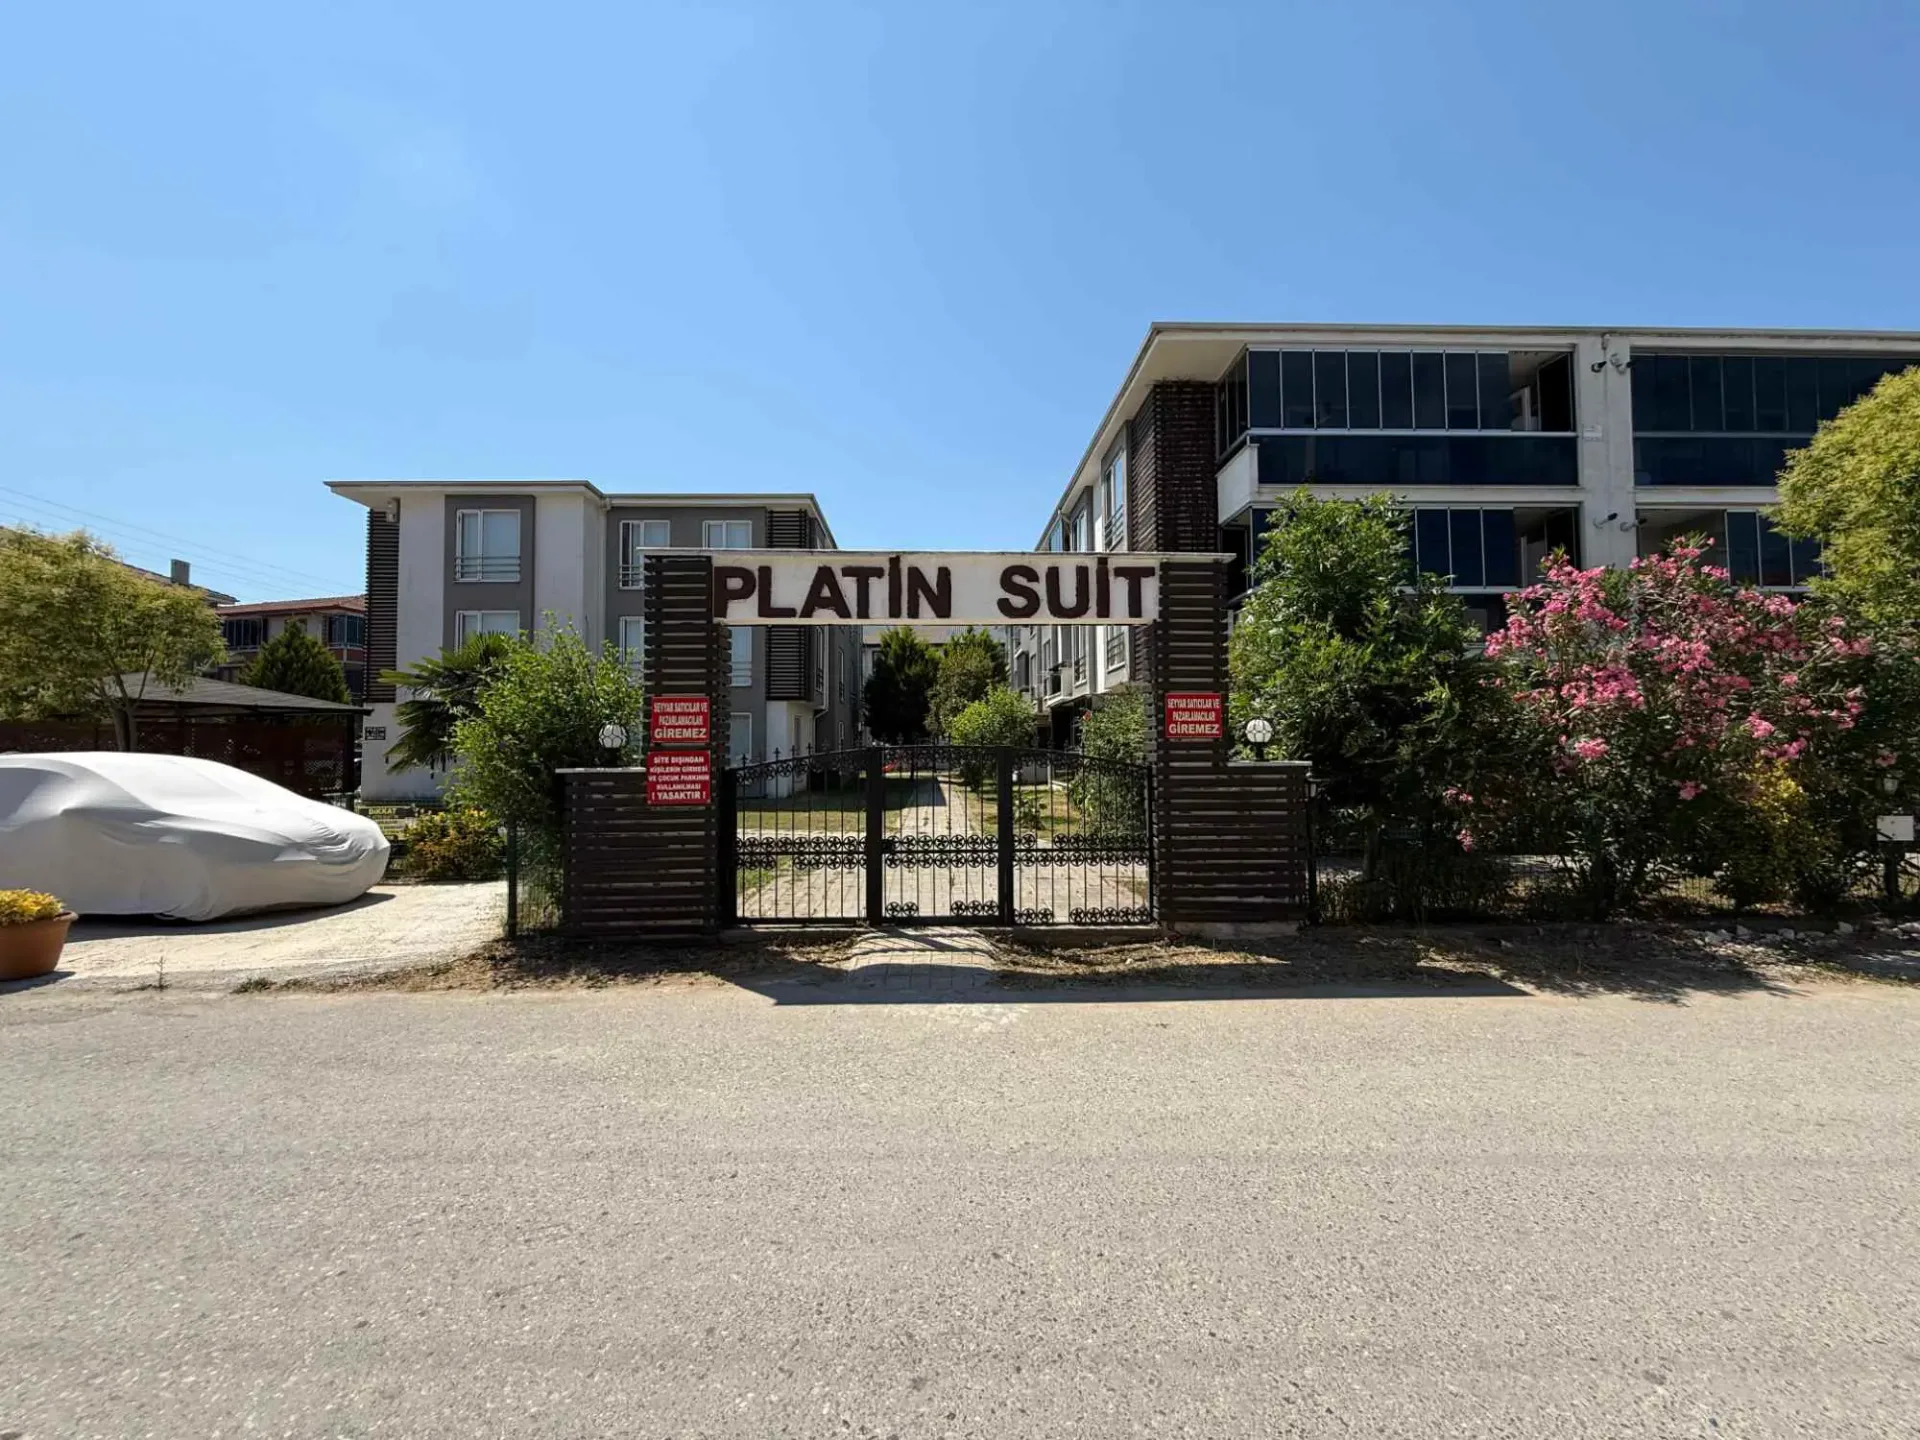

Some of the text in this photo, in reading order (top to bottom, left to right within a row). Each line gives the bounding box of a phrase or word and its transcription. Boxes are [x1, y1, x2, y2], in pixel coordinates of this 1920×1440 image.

[653, 702, 673, 713] SEYYAR
[701, 702, 708, 713] VE
[1168, 698, 1187, 708] SEYYAR
[1213, 698, 1220, 708] VE
[654, 727, 707, 738] GİREMEZ
[1168, 722, 1220, 734] GİREMEZ
[657, 791, 701, 800] YASAKTIR
